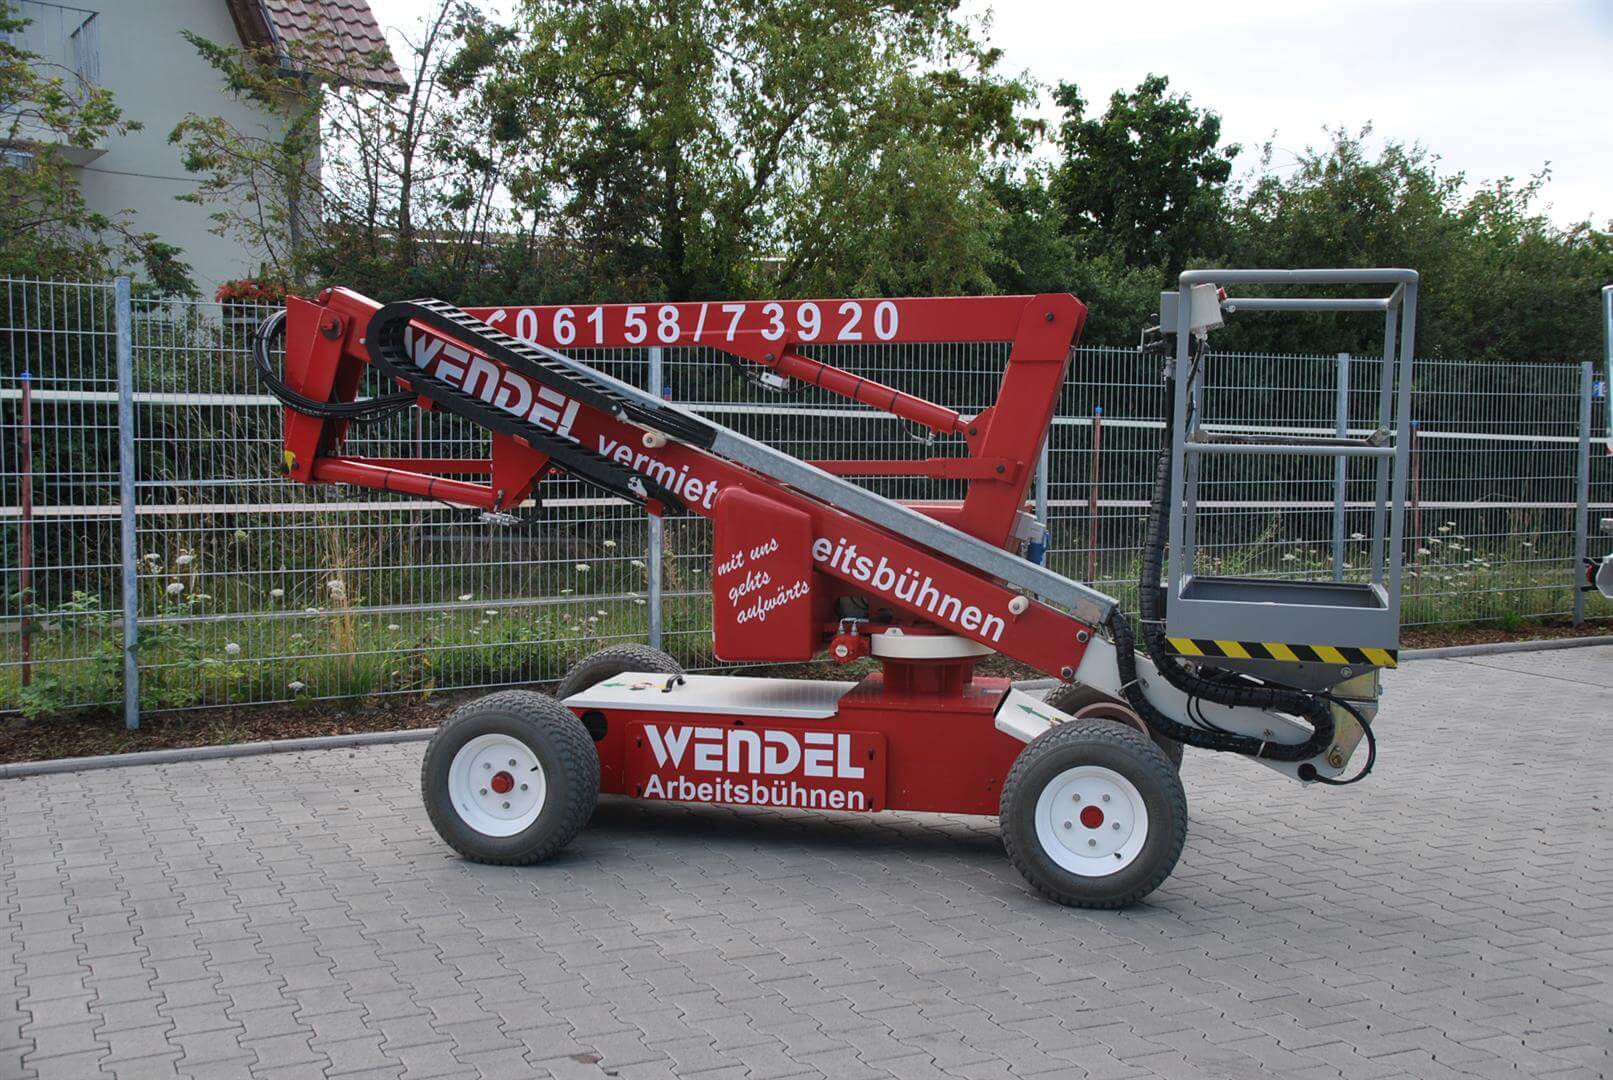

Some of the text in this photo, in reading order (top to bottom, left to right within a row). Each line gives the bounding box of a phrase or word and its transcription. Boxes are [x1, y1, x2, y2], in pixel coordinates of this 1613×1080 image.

[403, 326, 581, 444] WENDEL
[598, 434, 1005, 643] vermiet eitsbühnen
[717, 537, 779, 576] mit uns
[728, 569, 771, 607] gehts
[736, 579, 810, 624] aufwärts
[643, 724, 865, 779] WENDEL
[643, 773, 865, 811] Arbeitsbühnen
